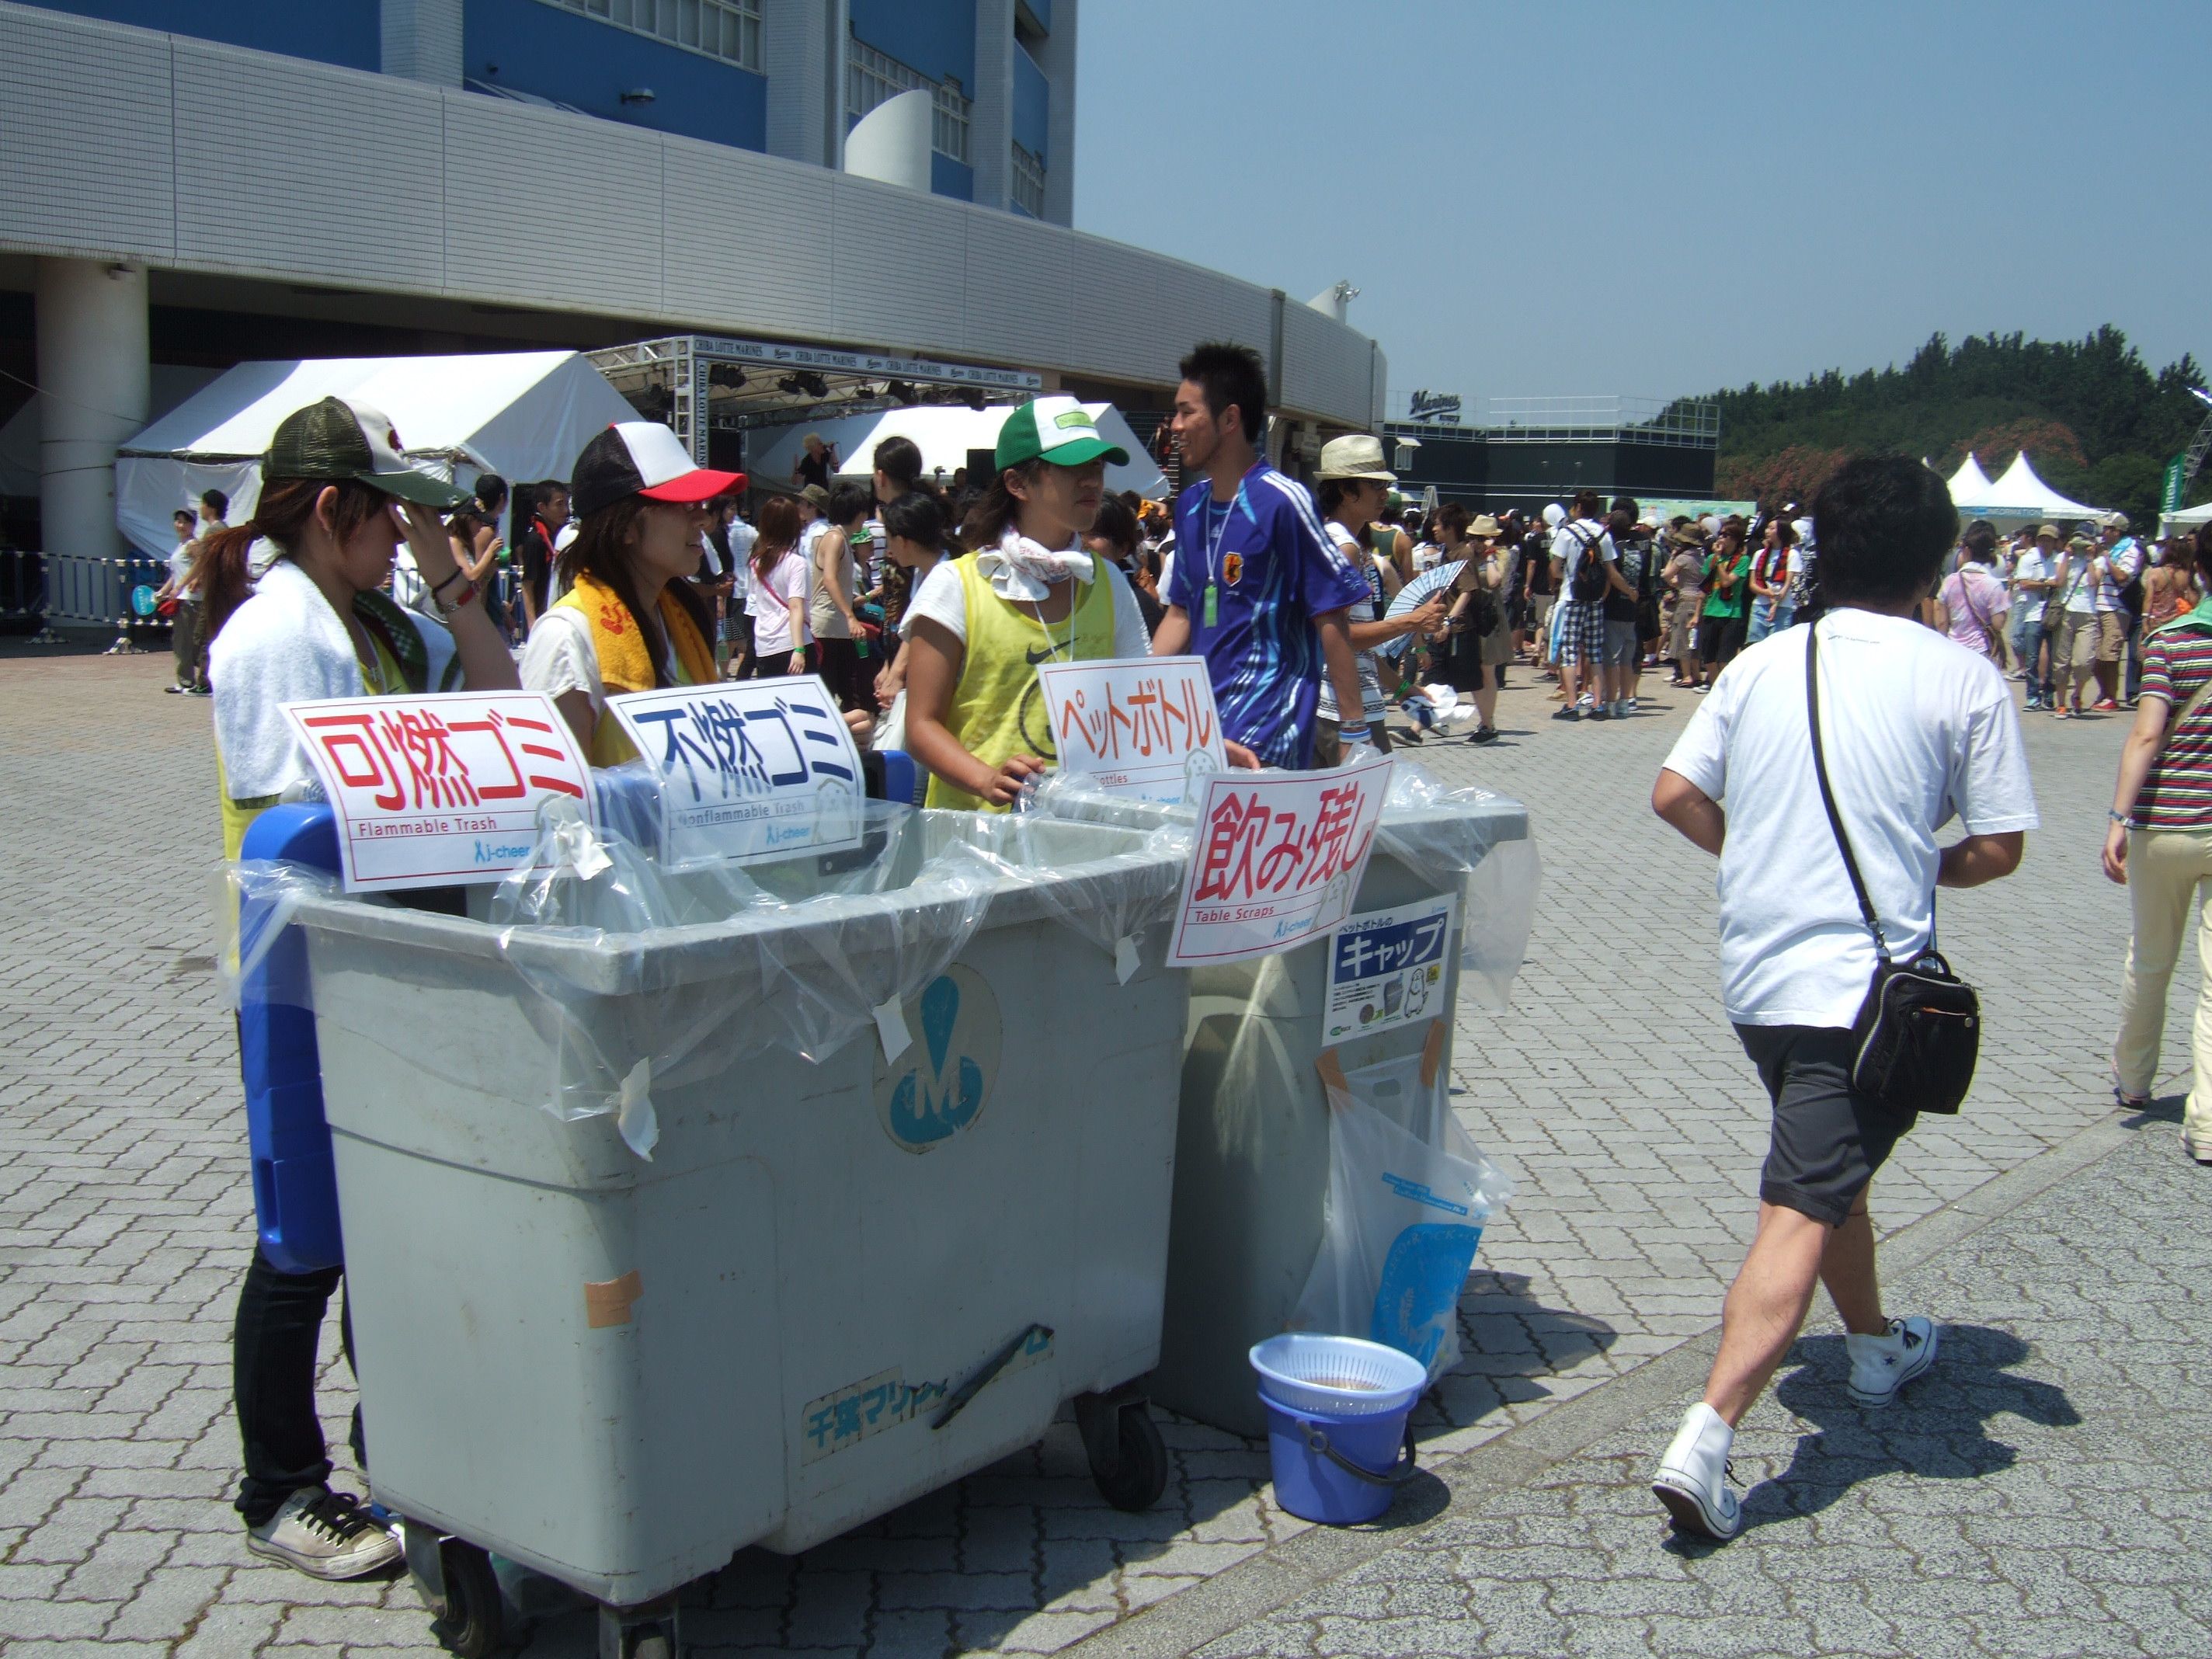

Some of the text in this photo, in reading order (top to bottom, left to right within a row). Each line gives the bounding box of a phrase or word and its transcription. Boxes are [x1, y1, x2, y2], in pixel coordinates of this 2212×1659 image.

[715, 341, 735, 353] LOTTE
[736, 343, 763, 356] MARINES
[1062, 678, 1212, 760] ペットボトル
[632, 696, 854, 803] 不燃ゴミ
[304, 708, 584, 812] 可燃ゴミ
[775, 800, 805, 814] Trash
[359, 816, 497, 836] Flammable Trash
[1195, 781, 1372, 901] 飲み残し
[486, 844, 530, 861] j-cheer
[1195, 905, 1275, 923] Table Scraps
[1339, 916, 1393, 933] ペットボトルの
[1341, 917, 1445, 977] キャップ
